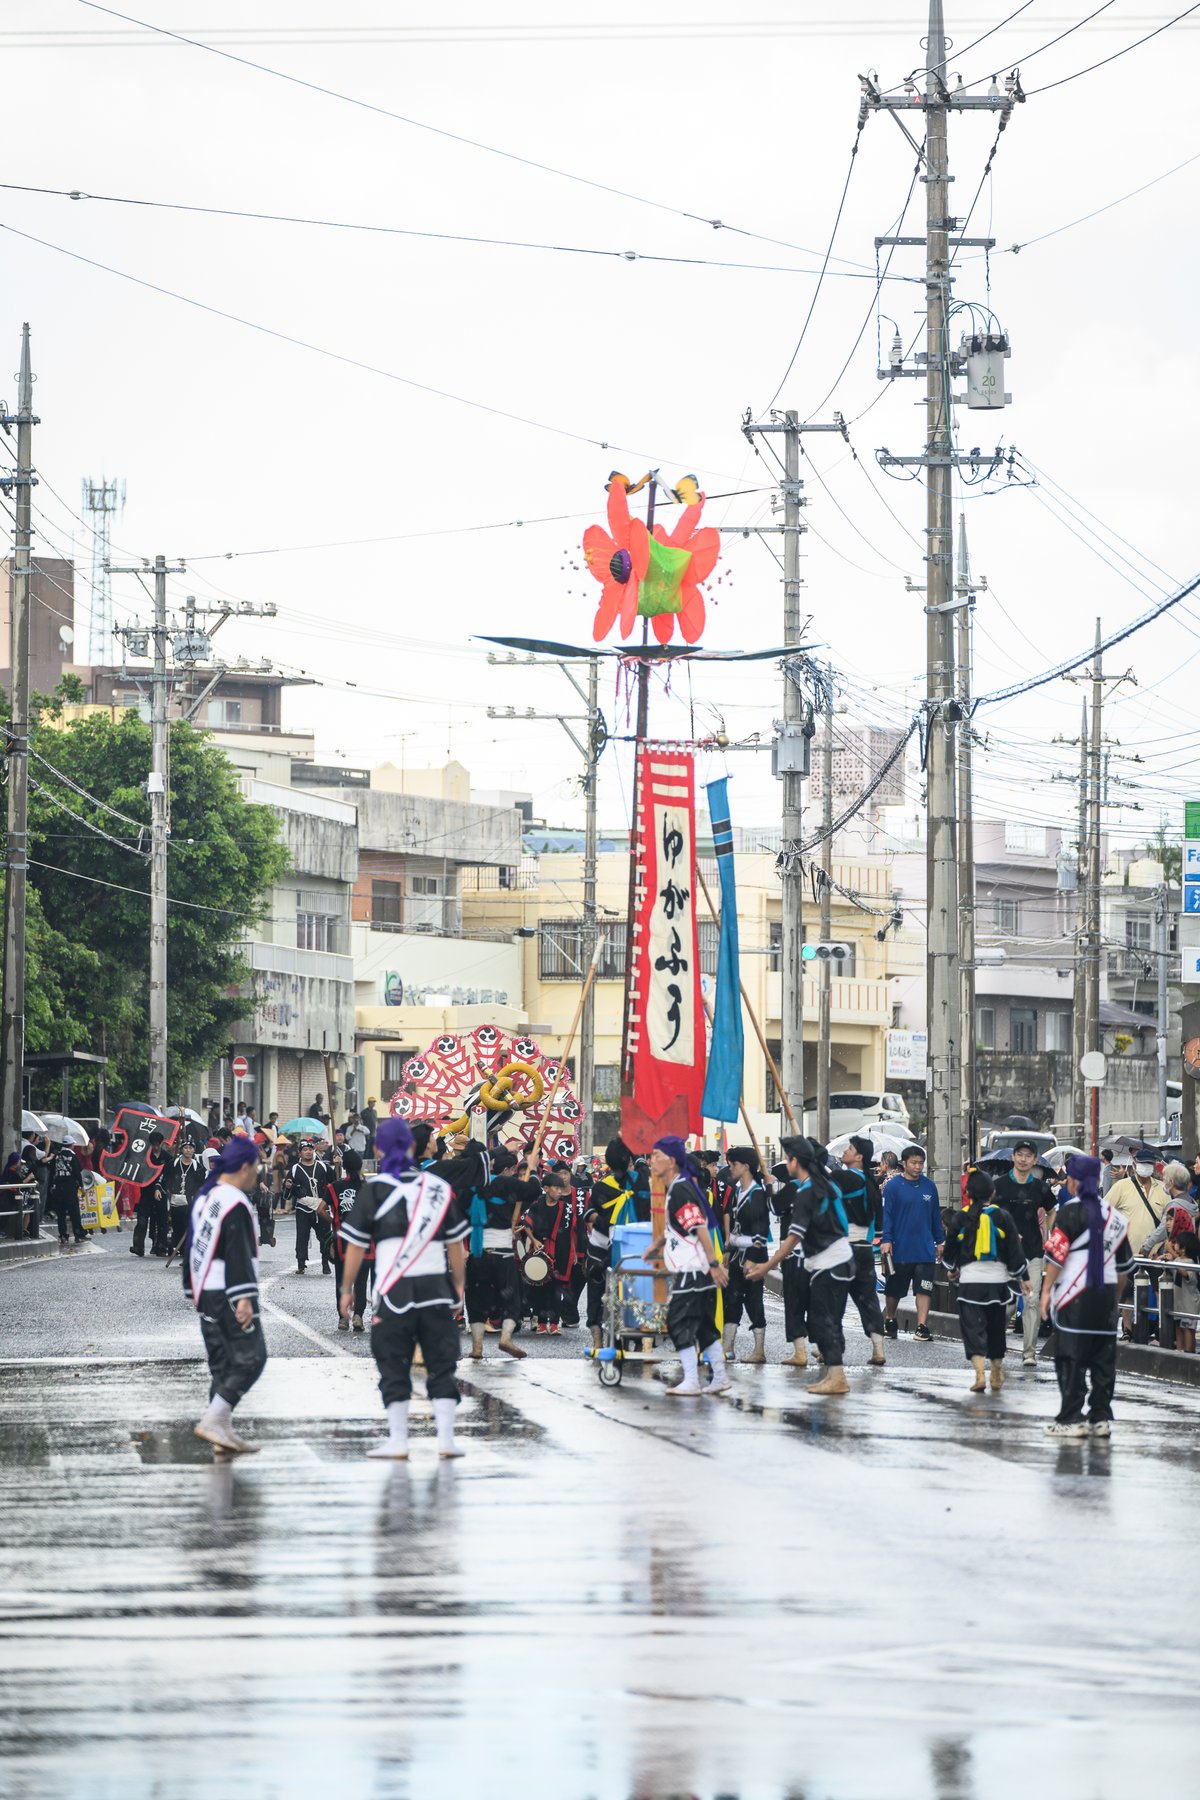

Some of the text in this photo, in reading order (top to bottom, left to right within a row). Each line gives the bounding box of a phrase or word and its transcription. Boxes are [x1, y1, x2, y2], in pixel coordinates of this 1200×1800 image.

[982, 375, 996, 387] 20
[654, 811, 689, 1051] ゆがふう
[120, 1117, 157, 1181] 西 川
